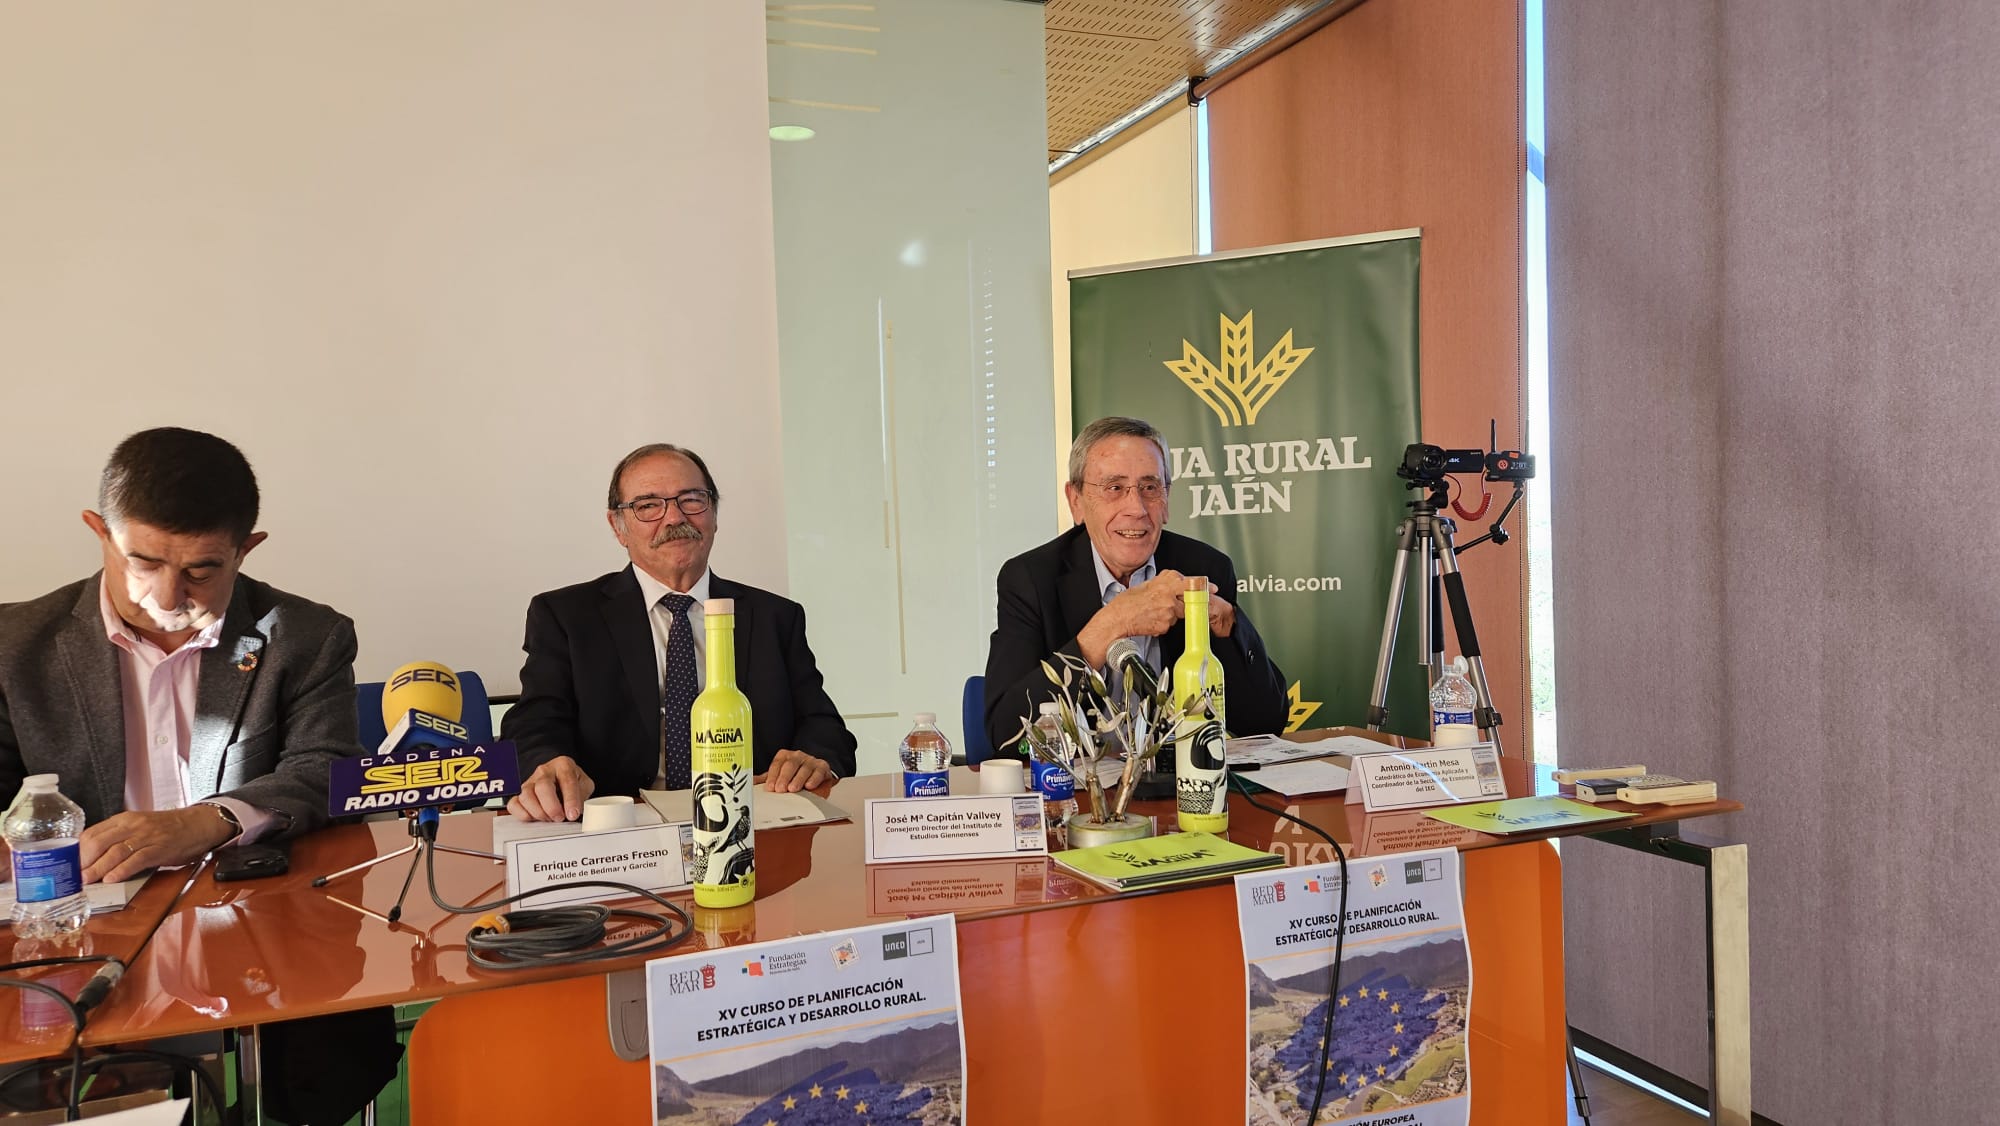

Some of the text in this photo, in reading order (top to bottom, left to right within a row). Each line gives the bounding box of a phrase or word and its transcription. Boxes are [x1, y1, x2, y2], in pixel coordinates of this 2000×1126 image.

[1170, 436, 1371, 482] JA RURAL
[1189, 477, 1292, 519] JAÉN
[1237, 575, 1342, 593] alvia.com
[390, 668, 457, 692] SER
[415, 712, 468, 741] SER
[361, 746, 485, 767] CADENA
[1380, 763, 1411, 773] Antonio
[1439, 759, 1460, 767] Mesa
[361, 756, 488, 795] SER
[914, 785, 947, 796] Primavera
[1371, 780, 1405, 789] Coordinador
[344, 779, 505, 811] RADIO JODAR
[885, 814, 908, 824] José
[926, 811, 964, 823] Capitán
[967, 811, 1001, 821] Vallvey
[885, 825, 920, 834] Consejero
[910, 831, 979, 840] Estudios Giennenses
[533, 848, 669, 873] Enrique Carreras Fresno
[547, 871, 577, 881] Alcalde
[578, 869, 589, 877] de
[590, 866, 621, 875] Bedmar
[1289, 918, 1303, 930] XV
[1305, 915, 1338, 927] CURSO
[1354, 899, 1422, 920] PLANIFICACIÓN
[1275, 927, 1339, 946] ESTRATÉGICA
[1349, 919, 1406, 935] DESARROLLO
[1409, 911, 1440, 925] RURAL.
[885, 940, 905, 952] UNED
[769, 951, 806, 963] Fundación
[769, 959, 807, 970] Estrategias
[669, 969, 700, 985] BED
[669, 980, 700, 995] MAR
[718, 977, 904, 1022] XV CURSO DE PLANIFICACIÓN
[697, 992, 927, 1042] ESTRATÉGICA Y DESARROLLO RURAL.
[1371, 1113, 1415, 1126] EUROPEA
